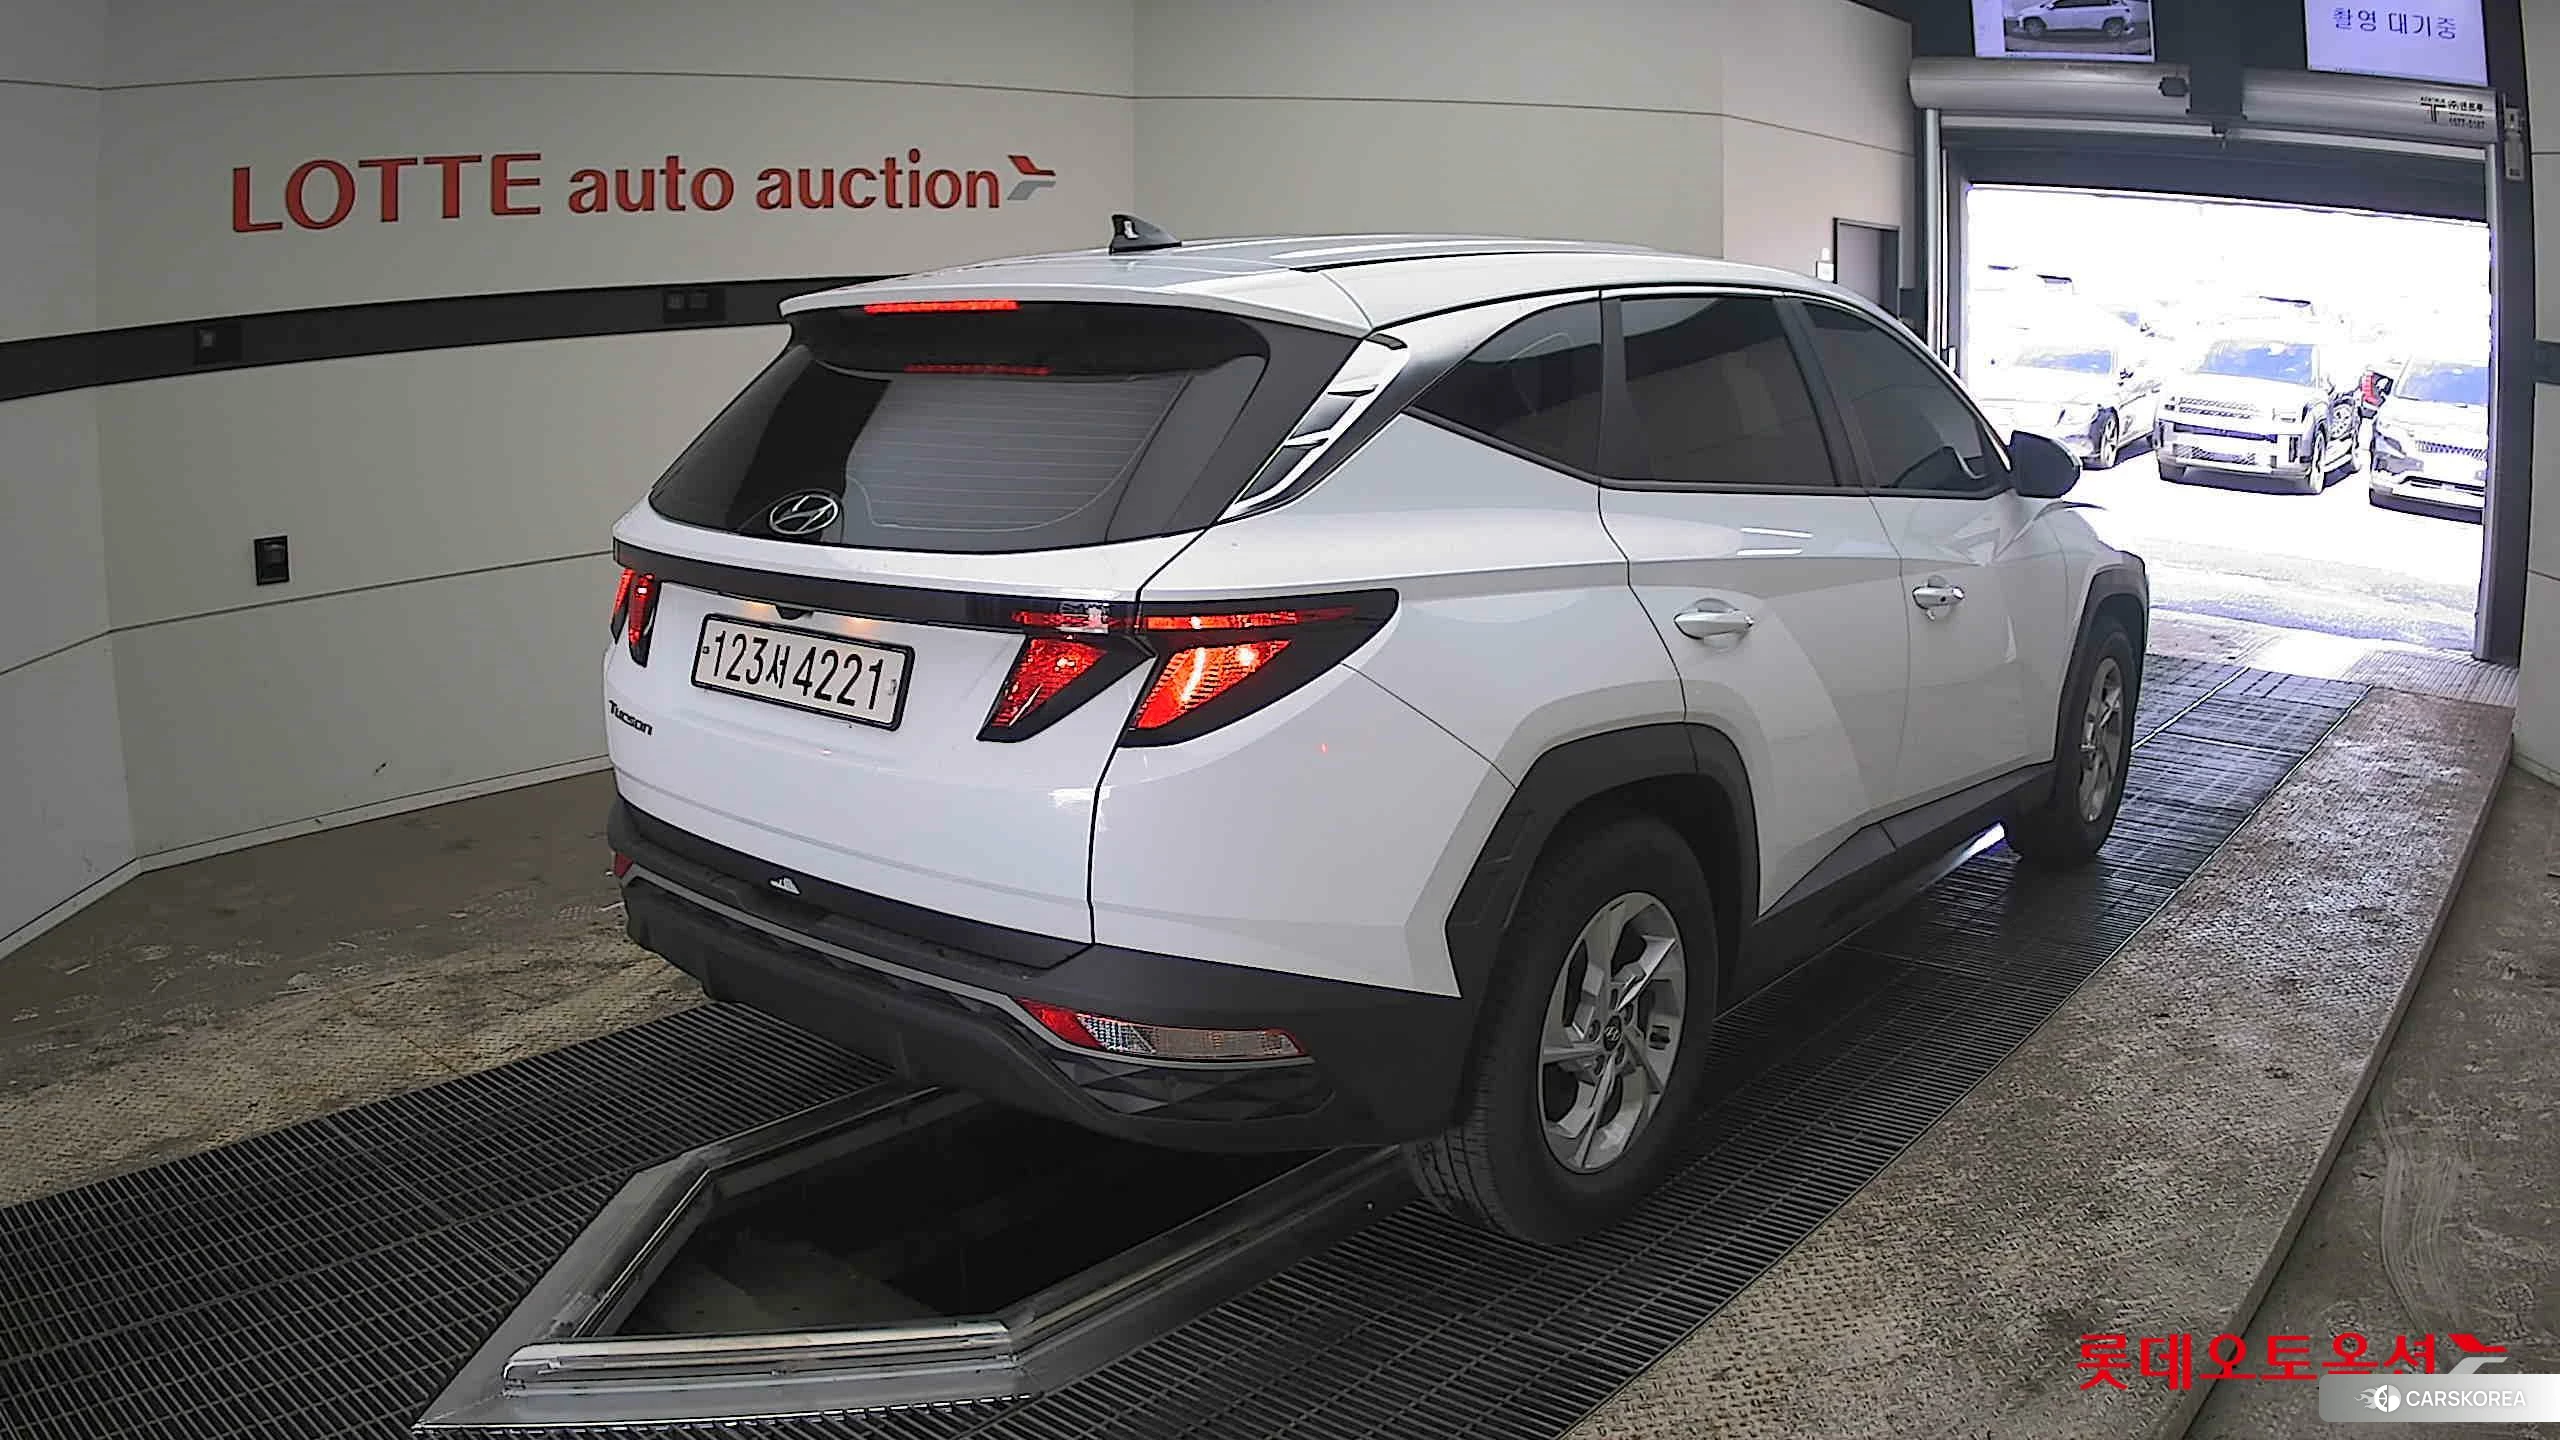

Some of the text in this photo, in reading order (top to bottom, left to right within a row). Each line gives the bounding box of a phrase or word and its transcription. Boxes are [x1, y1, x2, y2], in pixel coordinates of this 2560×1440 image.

[2333, 7, 2377, 33] 촬영
[232, 149, 1001, 233] LOTTE auto auction
[713, 629, 884, 710] 123서4221
